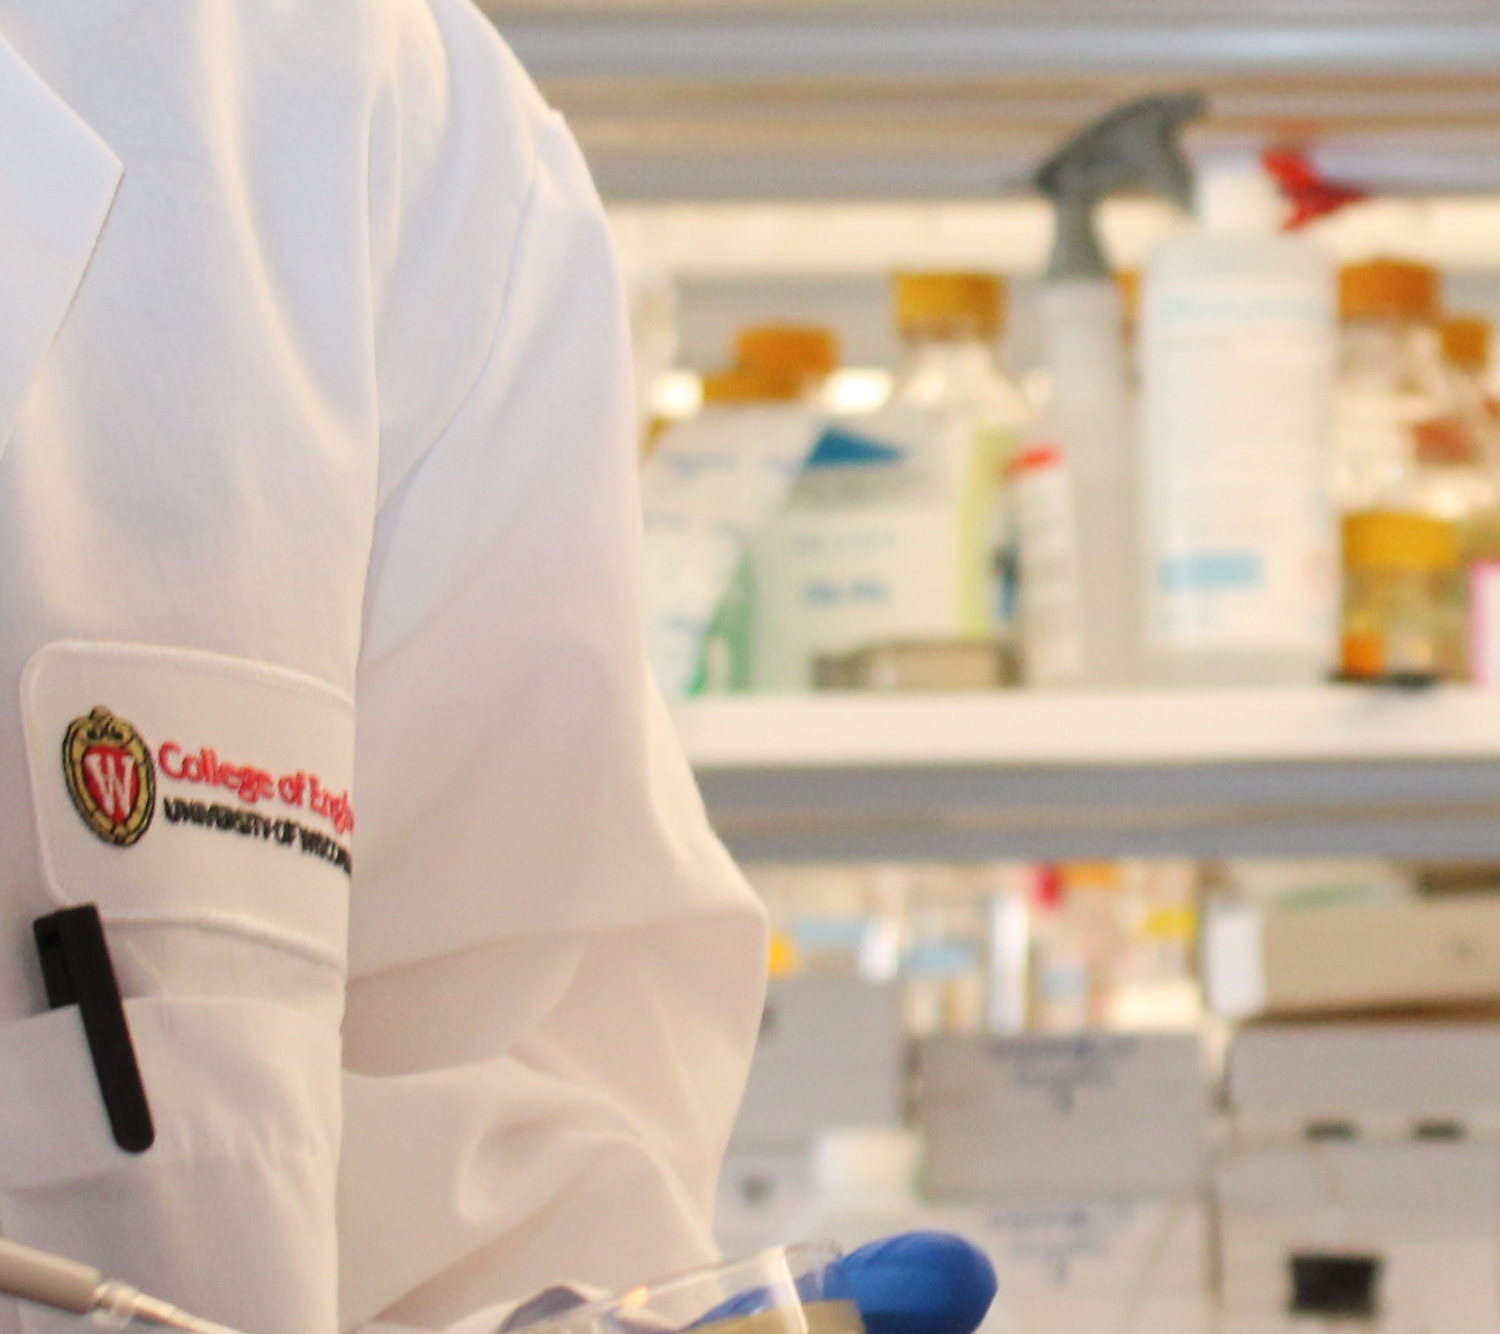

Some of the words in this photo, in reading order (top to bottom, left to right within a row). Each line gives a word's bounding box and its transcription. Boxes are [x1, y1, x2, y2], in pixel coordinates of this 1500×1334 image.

[158, 740, 275, 805] College
[278, 769, 307, 807] of
[162, 795, 272, 840] UNIVERSITY
[273, 818, 298, 847] OF
